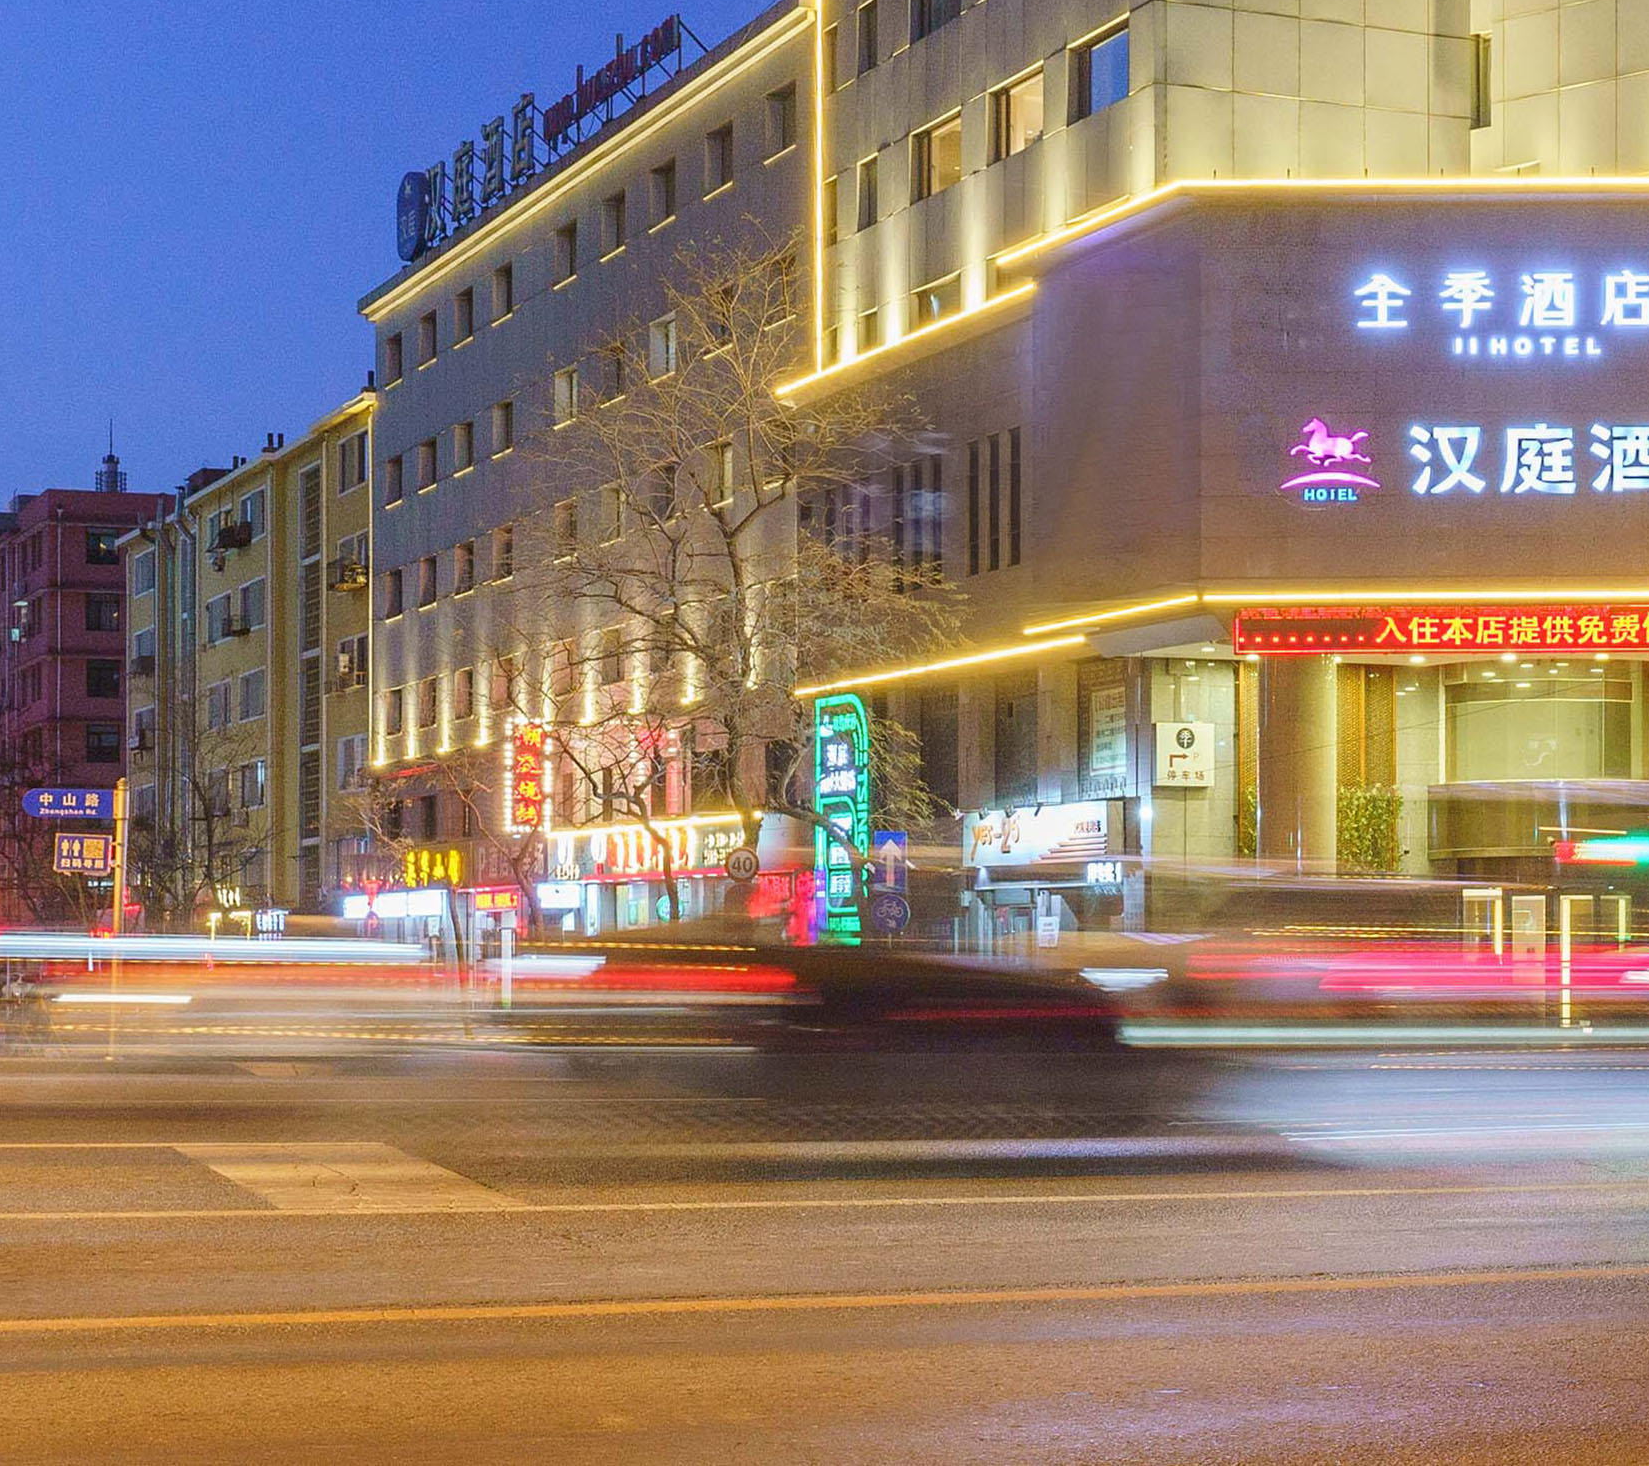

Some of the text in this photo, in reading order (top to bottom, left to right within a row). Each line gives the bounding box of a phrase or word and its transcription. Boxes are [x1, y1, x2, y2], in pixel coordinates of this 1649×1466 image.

[1490, 337, 1601, 355] HOTEL
[1304, 488, 1358, 501] HOTEL
[1167, 770, 1205, 782] 停车场
[39, 792, 100, 807] 中山路
[39, 808, 84, 816] Zhongshan
[731, 855, 754, 873] 40
